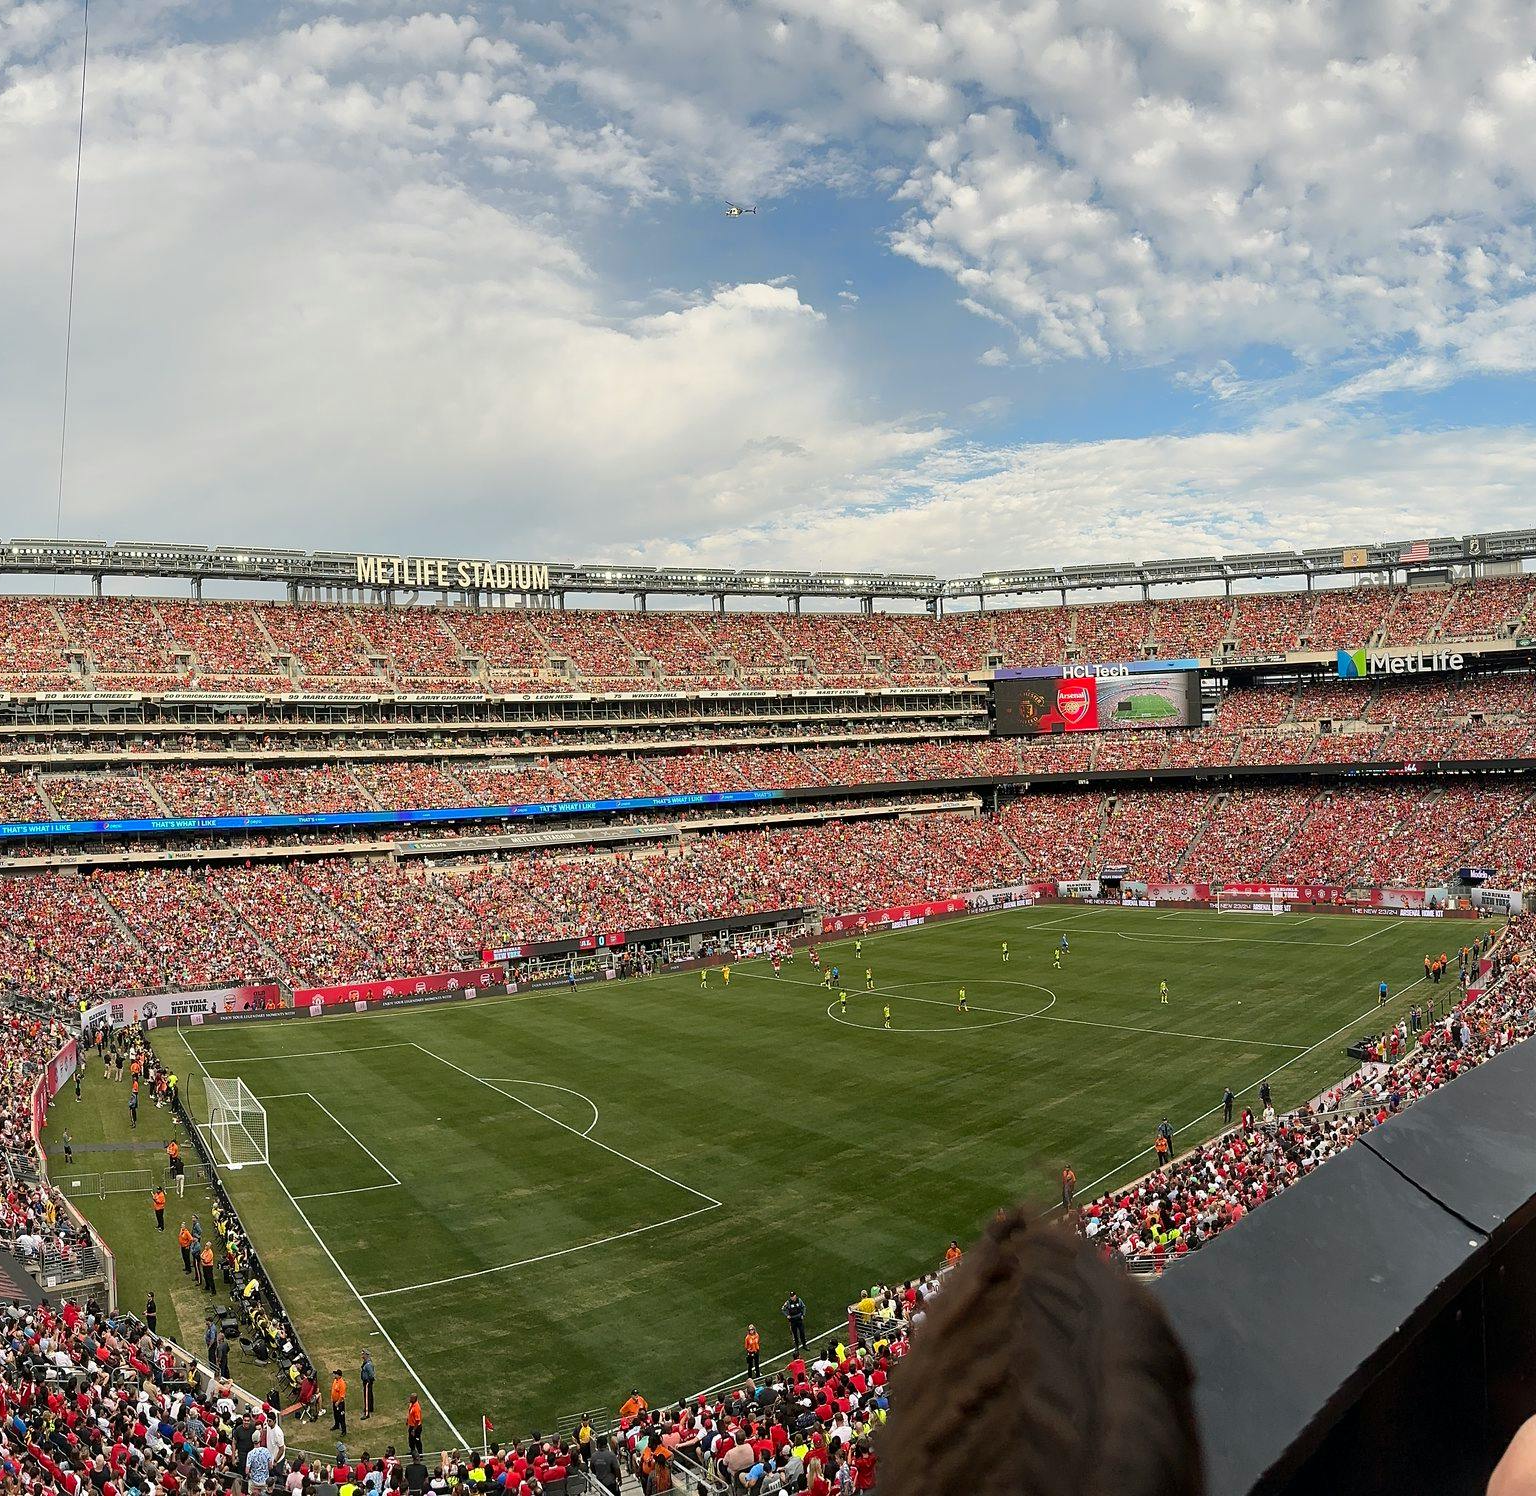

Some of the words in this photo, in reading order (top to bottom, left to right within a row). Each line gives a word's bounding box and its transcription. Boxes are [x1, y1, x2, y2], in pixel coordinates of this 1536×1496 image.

[357, 556, 450, 587] METLIFE
[457, 561, 549, 590] STADIUM
[1370, 648, 1464, 675] MetLife
[1063, 663, 1129, 680] HCLTech
[558, 803, 578, 811] WHAT
[582, 802, 596, 810] LIKE
[2, 826, 28, 834] THAT'S
[55, 824, 71, 832] LIKE
[510, 834, 542, 844] METLIFE
[544, 832, 576, 842] STADIUM
[1399, 909, 1421, 917] ARSENAL
[599, 936, 605, 946] 0
[171, 1006, 188, 1014] NEW
[189, 1004, 209, 1013] YORK.
